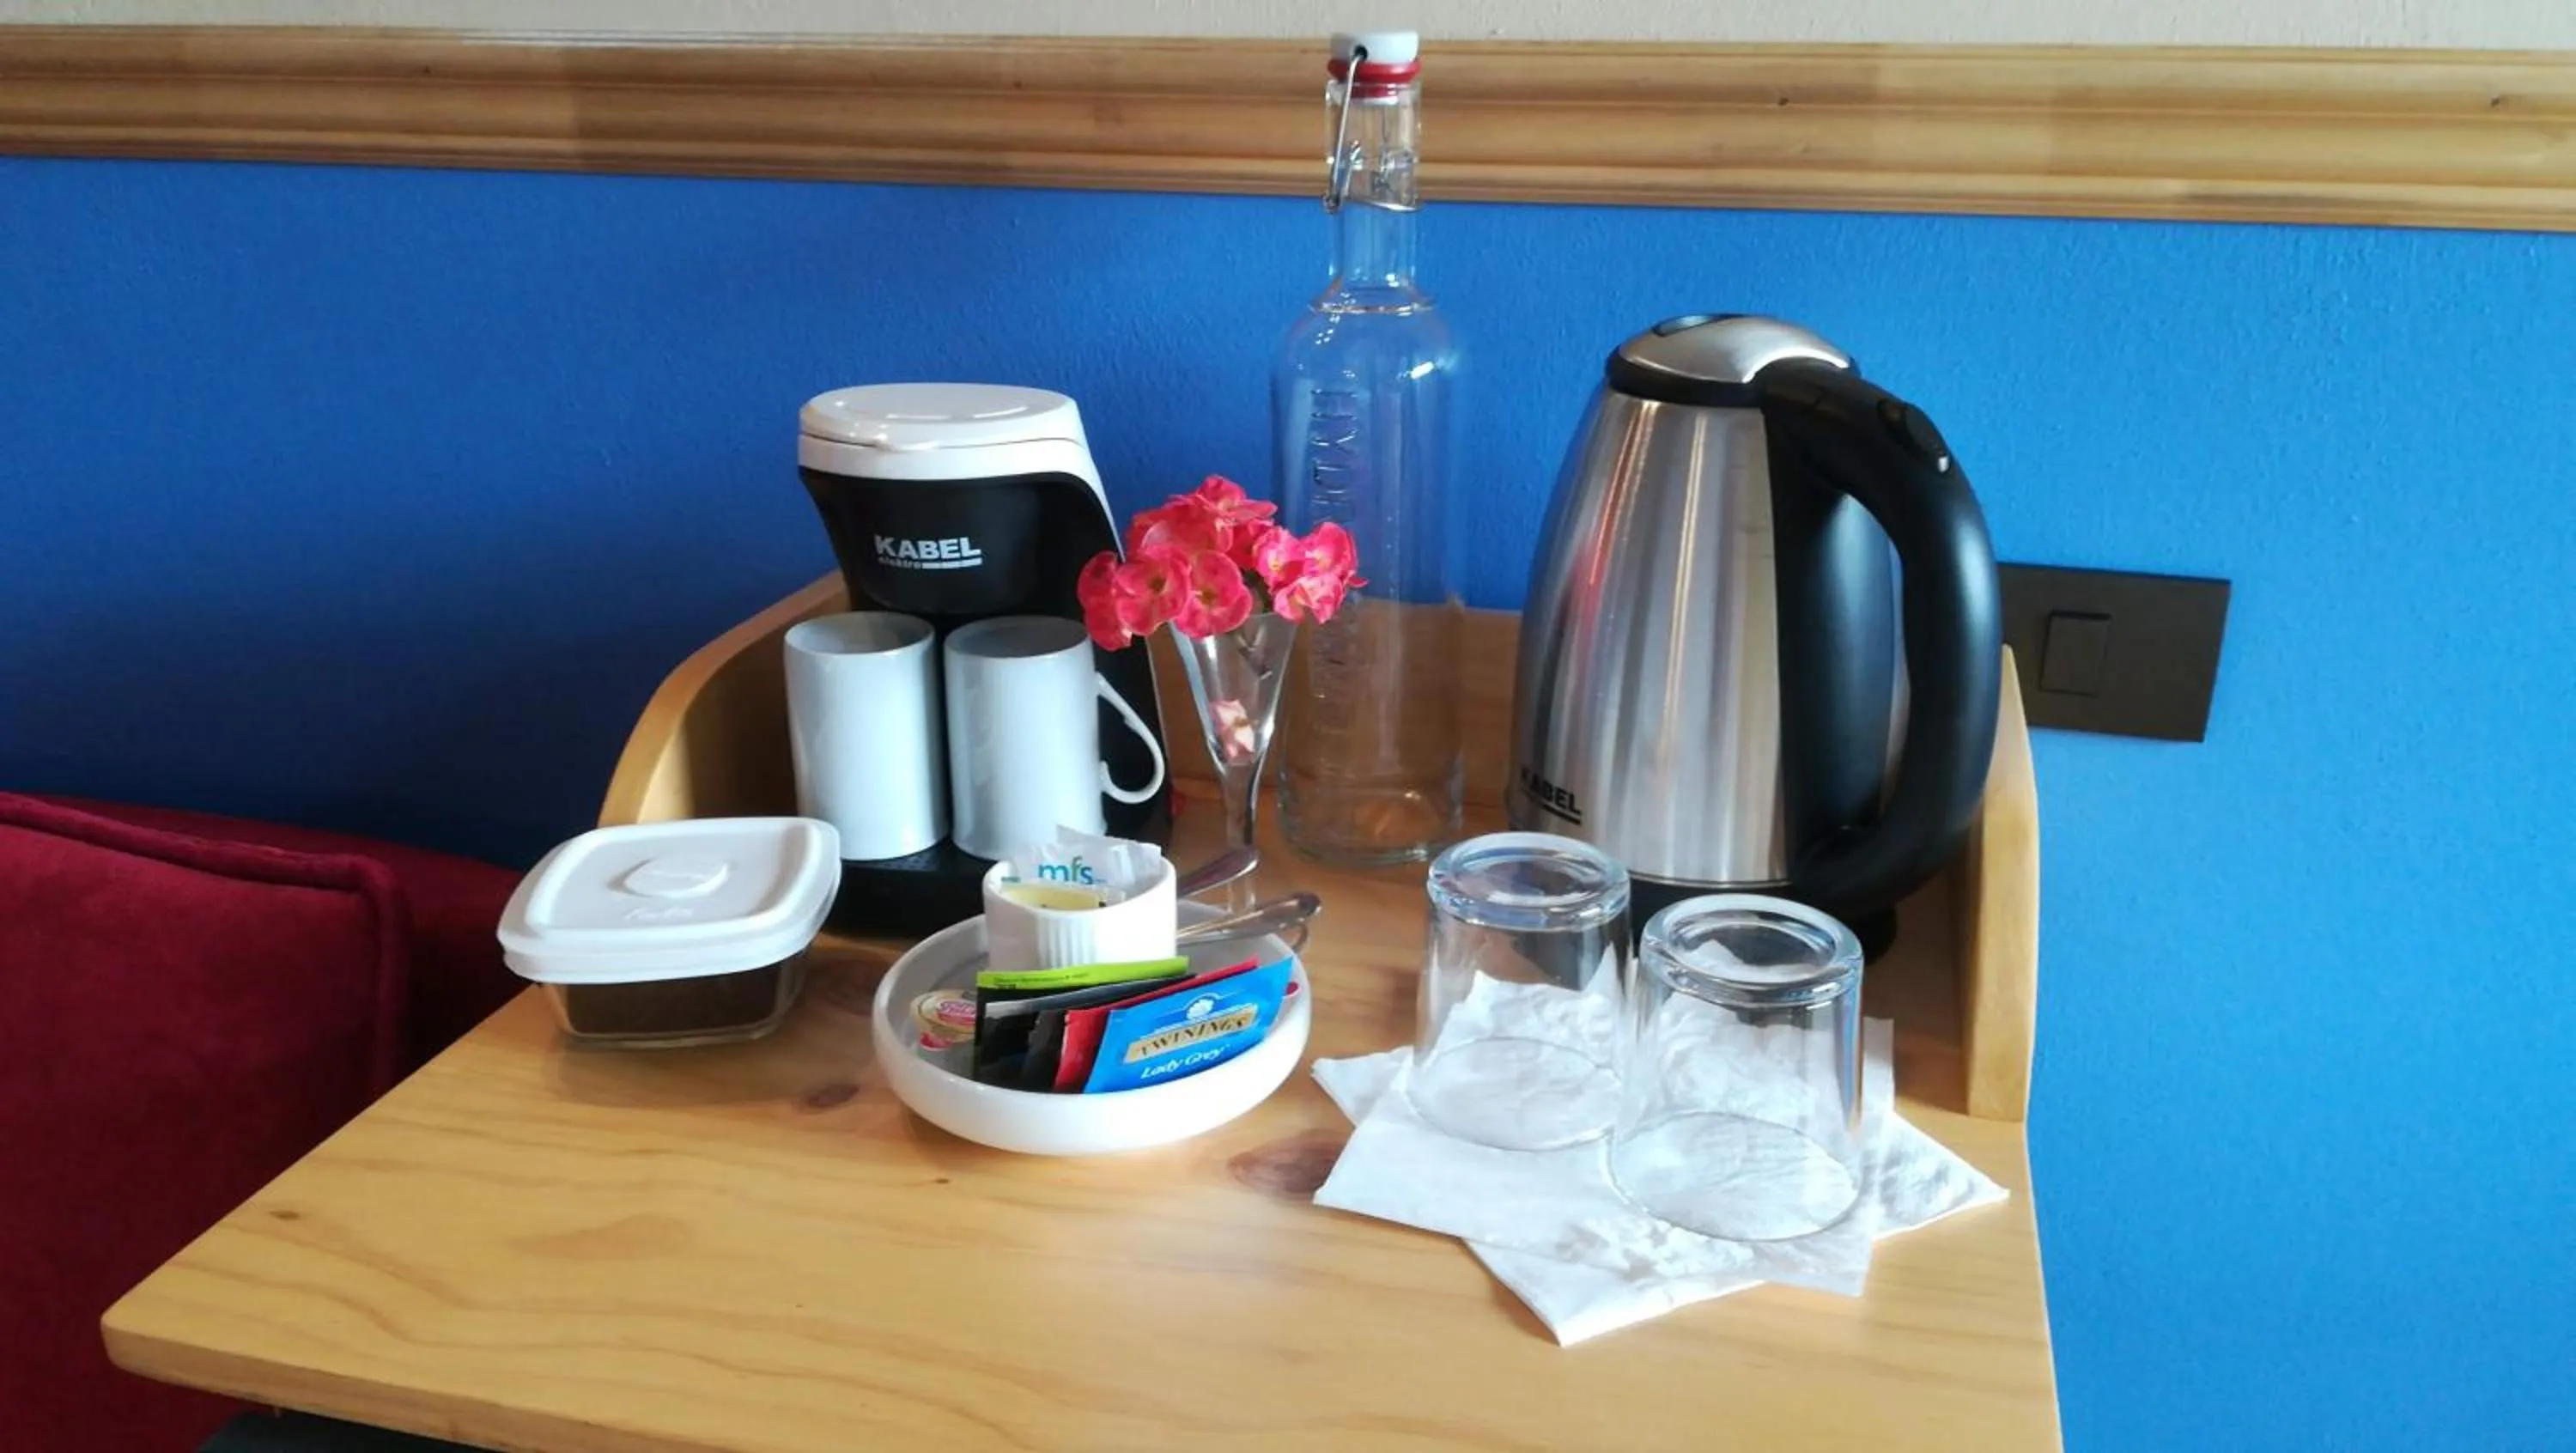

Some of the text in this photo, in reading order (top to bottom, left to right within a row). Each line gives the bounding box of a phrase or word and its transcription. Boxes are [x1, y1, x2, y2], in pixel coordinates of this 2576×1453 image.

[874, 534, 981, 559] KABEL
[1521, 766, 1582, 817] KABEL
[1037, 855, 1093, 885] mfs
[1138, 1013, 1249, 1056] TWININGS
[1140, 1045, 1230, 1079] Lady Grey
